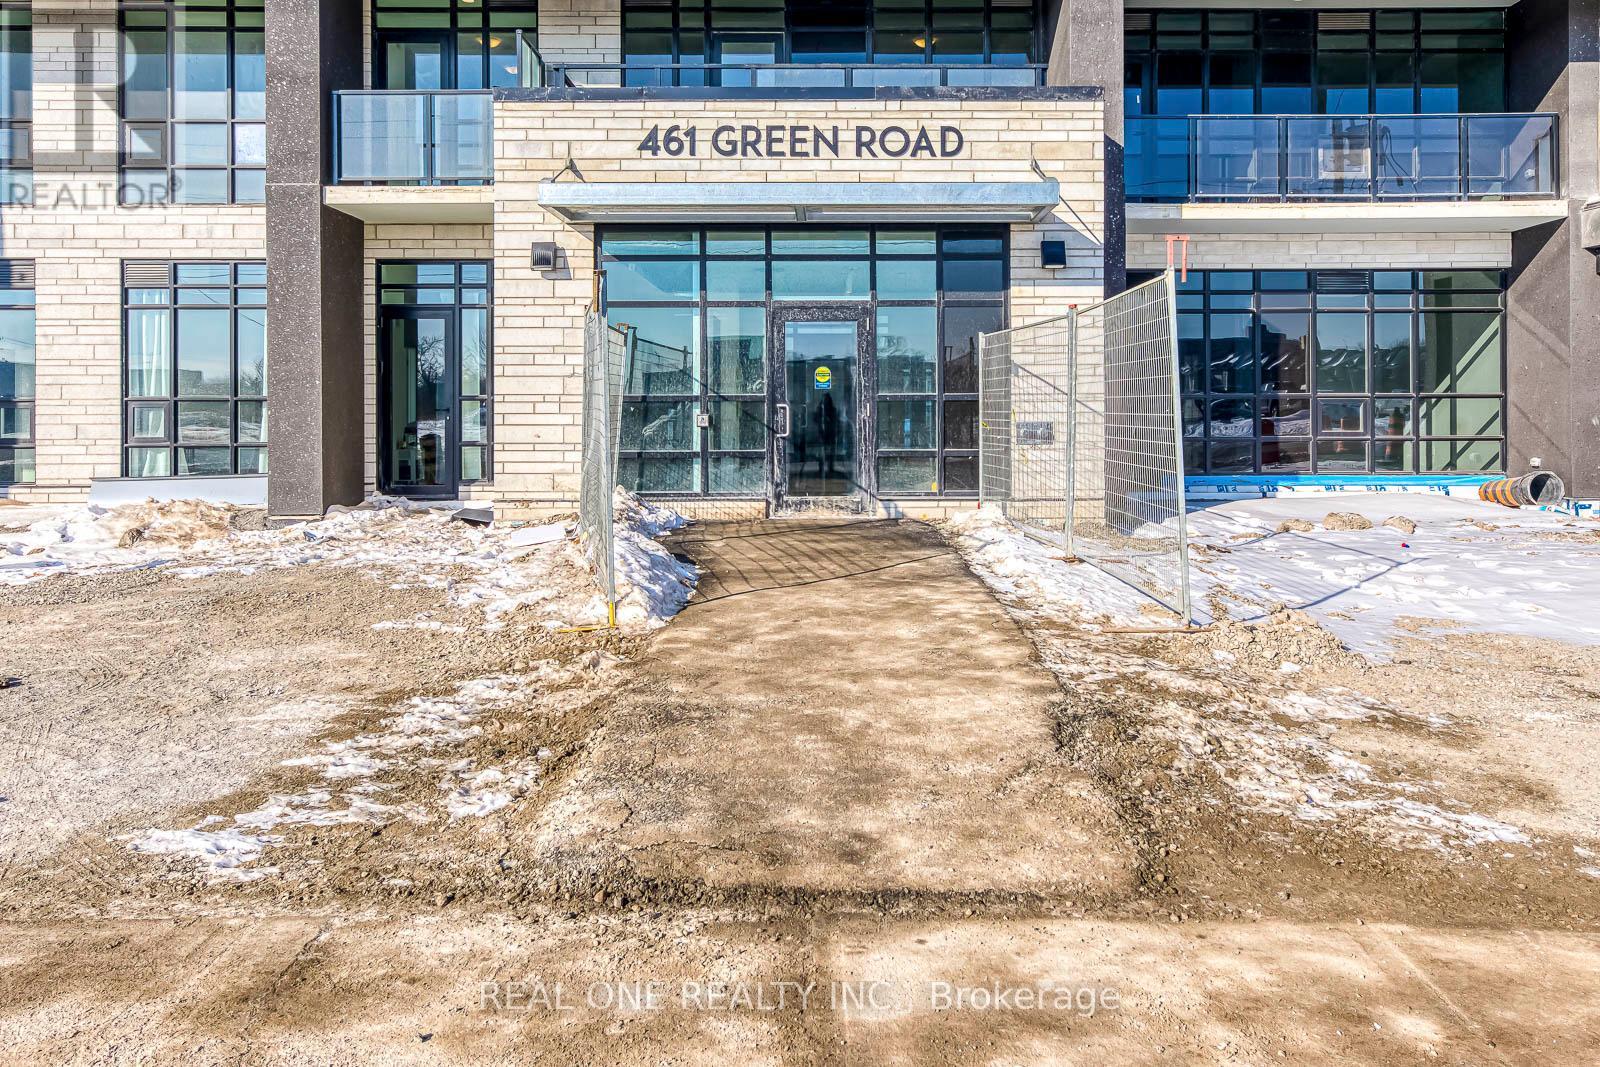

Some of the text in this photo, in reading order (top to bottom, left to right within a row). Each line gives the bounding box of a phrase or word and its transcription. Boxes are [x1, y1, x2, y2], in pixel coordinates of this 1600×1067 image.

[637, 124, 964, 158] 461 GREEN ROAD
